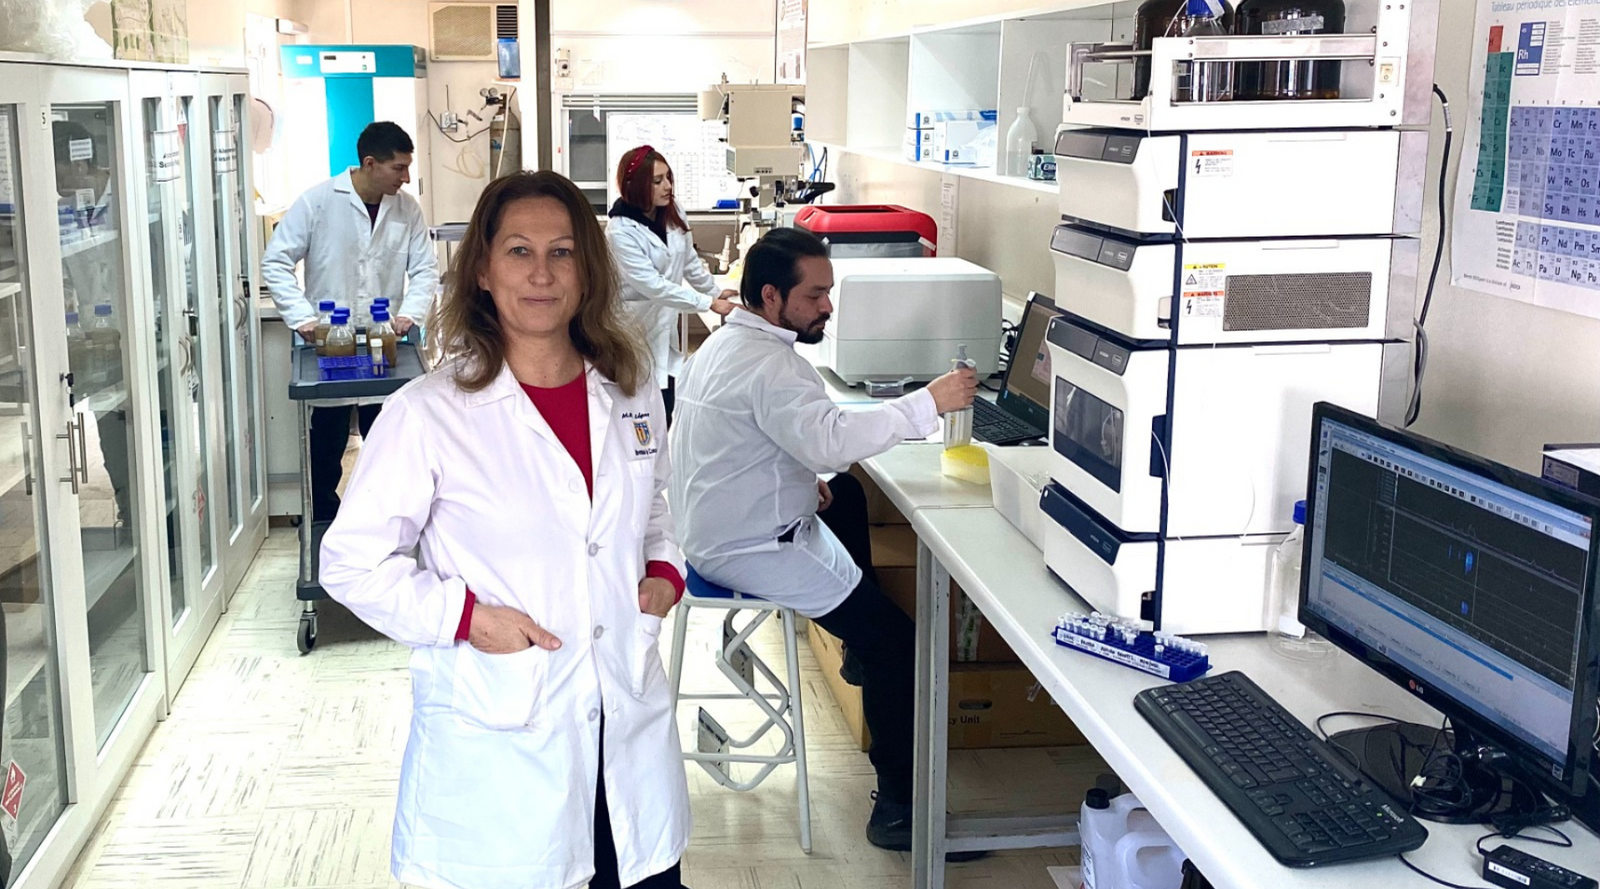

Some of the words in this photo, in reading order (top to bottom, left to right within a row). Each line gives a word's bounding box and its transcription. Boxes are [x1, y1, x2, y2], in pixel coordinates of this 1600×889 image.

[1491, 1, 1515, 12] Tableau
[1518, 49, 1529, 60] Rh
[1552, 119, 1563, 129] Cr
[1570, 119, 1584, 130] Mn
[1588, 120, 1598, 131] Fe
[1550, 147, 1563, 158] Mo
[1567, 148, 1576, 159] Tc
[1584, 149, 1595, 159] Ru
[1547, 175, 1556, 185] W
[1564, 176, 1574, 187] Re
[1580, 178, 1590, 189] Os
[1544, 203, 1554, 217] Sg
[1560, 205, 1570, 216] Bh
[1577, 207, 1587, 218] Hs
[1541, 236, 1550, 247] Pr
[1557, 239, 1568, 249] Nd
[1574, 241, 1585, 252] Pm
[1512, 258, 1521, 269] Ac
[1526, 260, 1533, 271] Th
[1538, 263, 1547, 274] Pa
[1554, 266, 1561, 276] U
[1570, 269, 1582, 282] Np
[1587, 271, 1597, 283] Pu
[1415, 684, 1424, 695] LG
[960, 714, 980, 724] Unit
